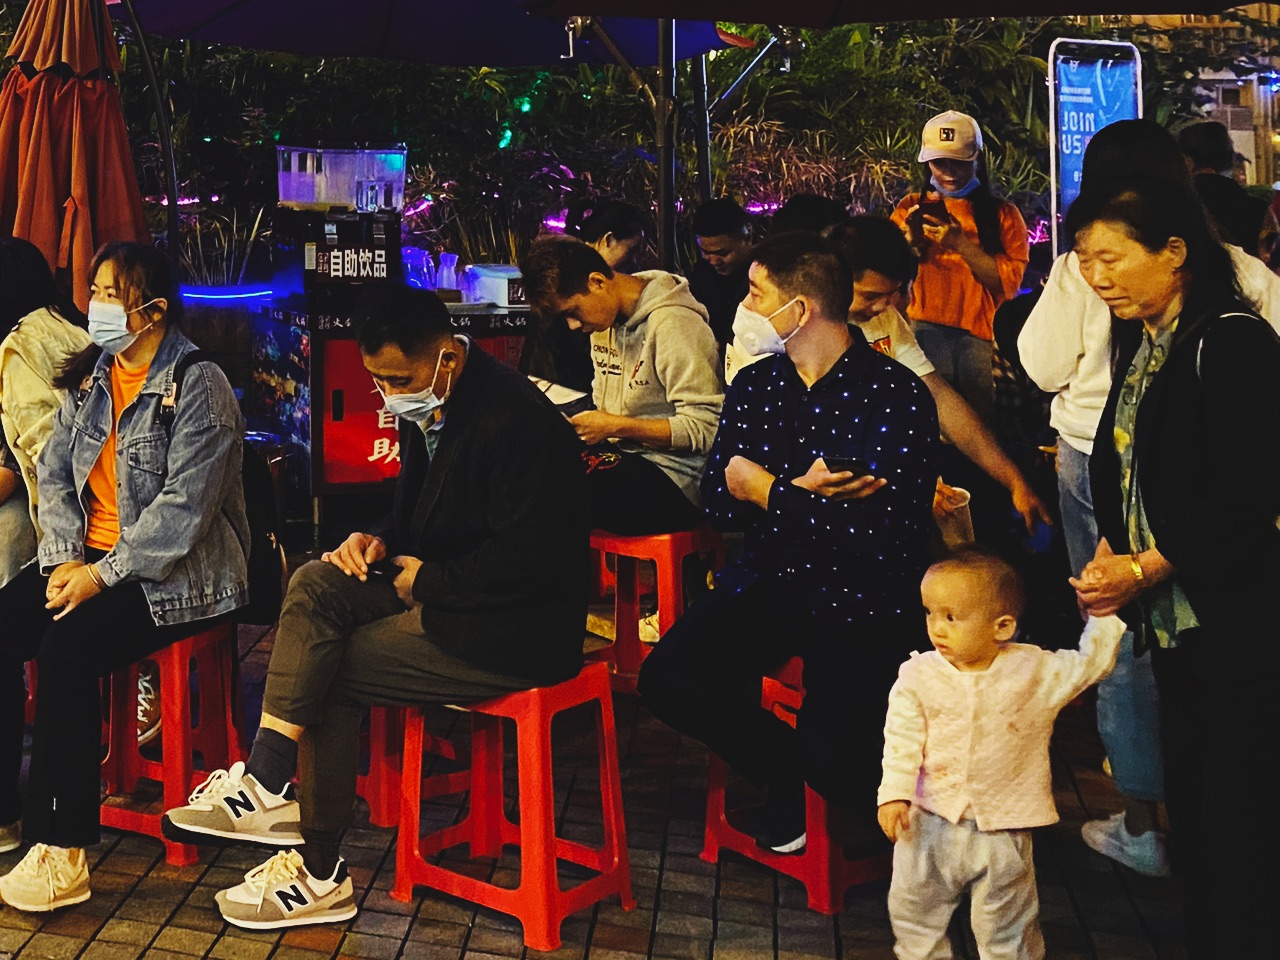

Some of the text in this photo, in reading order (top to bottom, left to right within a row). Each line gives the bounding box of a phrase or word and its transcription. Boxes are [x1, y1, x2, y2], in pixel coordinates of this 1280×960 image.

[1062, 111, 1095, 132] JOIN
[1062, 134, 1082, 155] US
[330, 248, 387, 277] 自助饮品
[223, 790, 256, 819] N
[274, 883, 309, 913] N
